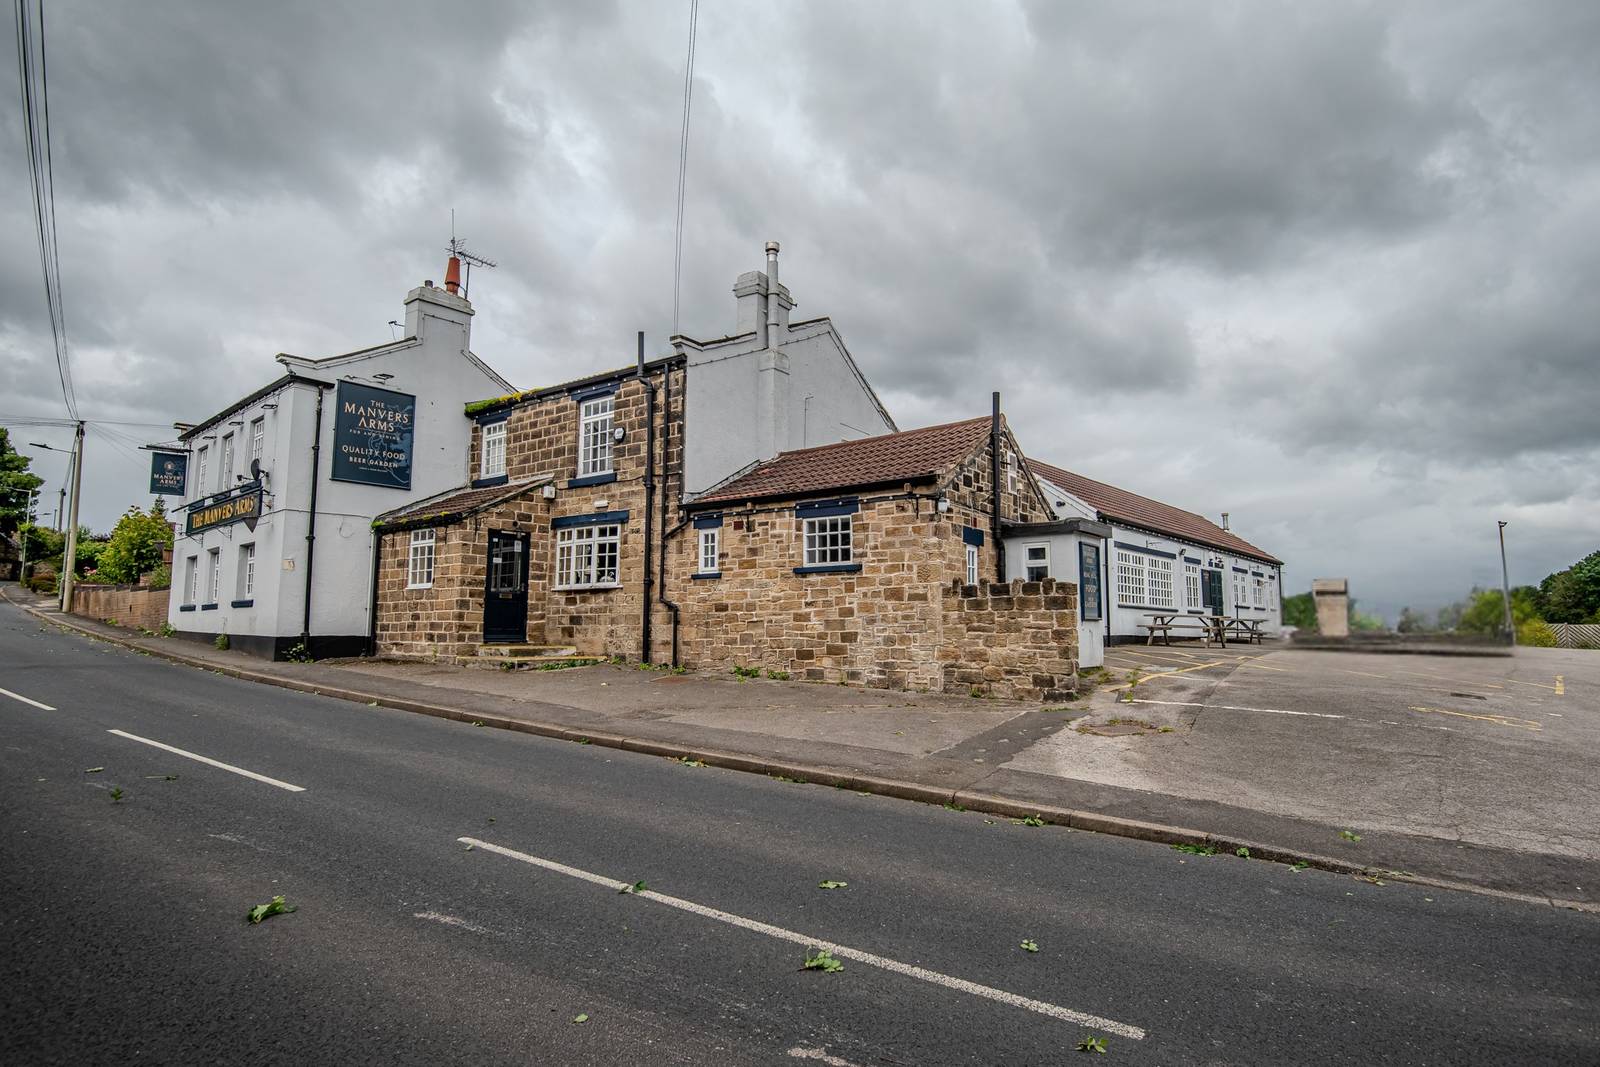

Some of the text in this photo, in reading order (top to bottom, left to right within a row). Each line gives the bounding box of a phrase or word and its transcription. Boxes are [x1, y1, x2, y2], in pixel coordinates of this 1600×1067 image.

[371, 400, 385, 409] THE
[344, 402, 409, 424] MANVERS
[359, 417, 395, 432] ARMS
[342, 445, 406, 460] QUALITY FOOD
[349, 456, 398, 468] BEER GARDEN
[193, 496, 255, 529] THE MANVERS ARMS
